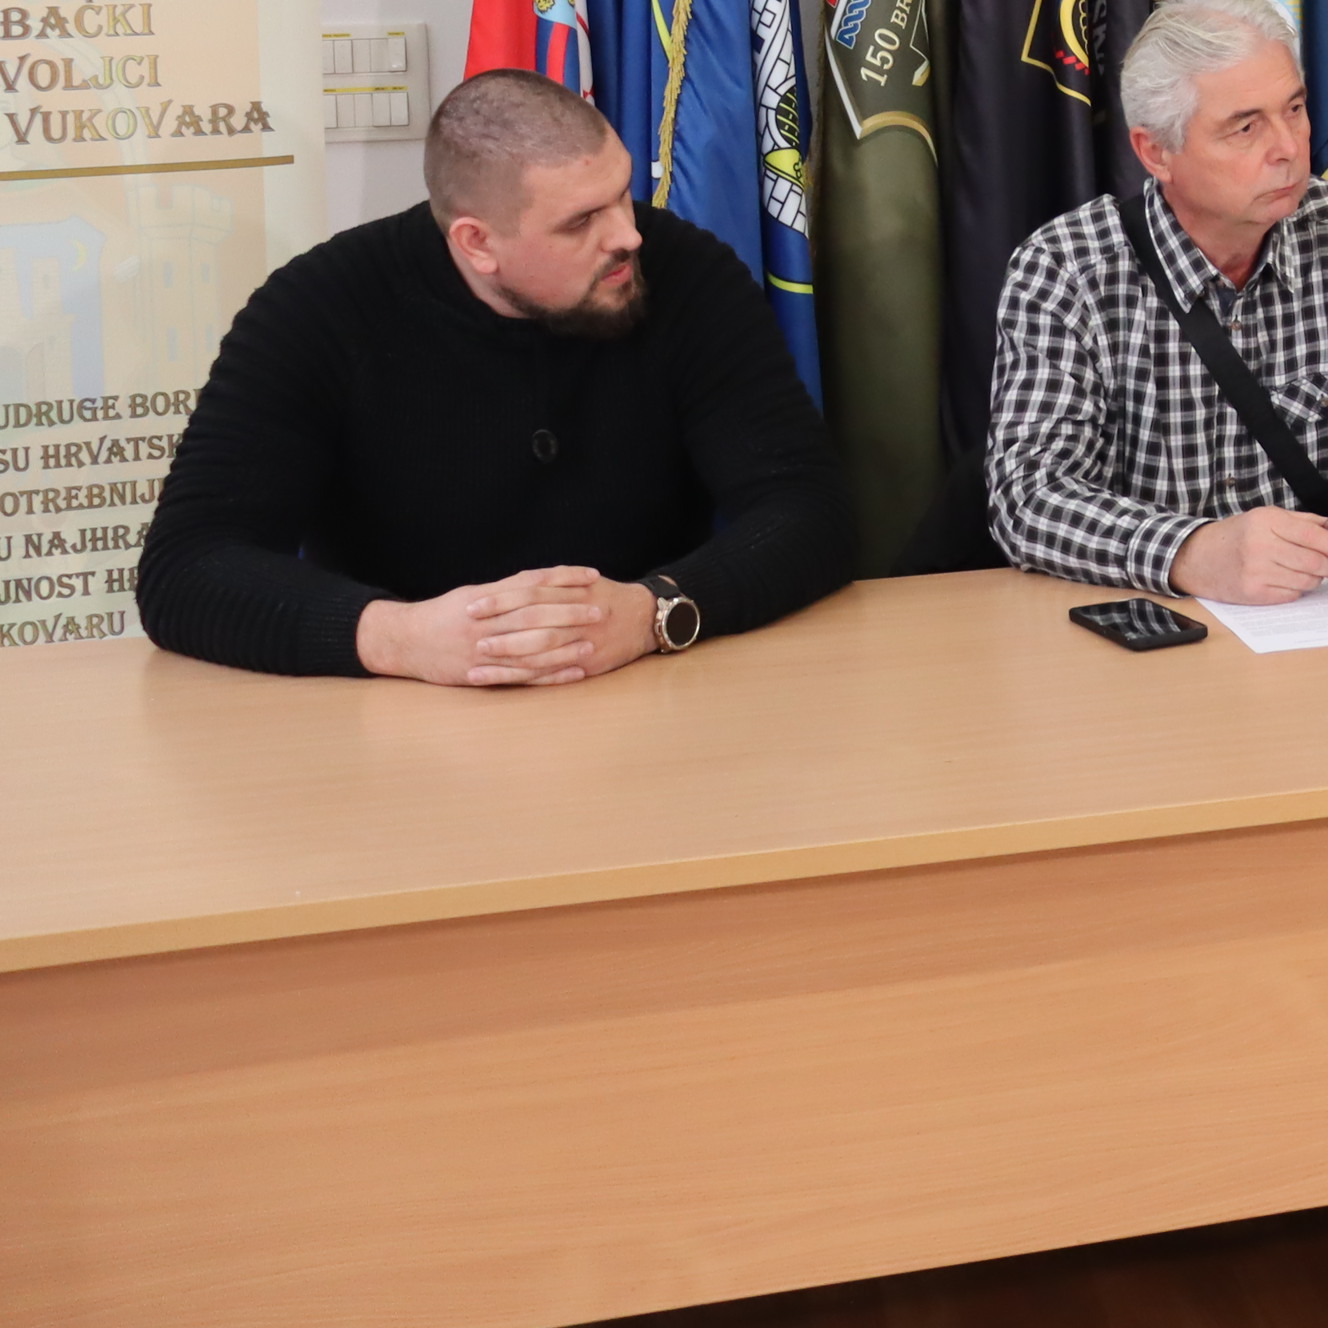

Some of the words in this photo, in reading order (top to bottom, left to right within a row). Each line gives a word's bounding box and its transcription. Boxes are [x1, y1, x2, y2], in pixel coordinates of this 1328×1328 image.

[0, 53, 162, 93] VOLJCI
[860, 27, 900, 87] 150
[4, 99, 276, 145] VUKOVARA
[128, 388, 200, 419] BOR
